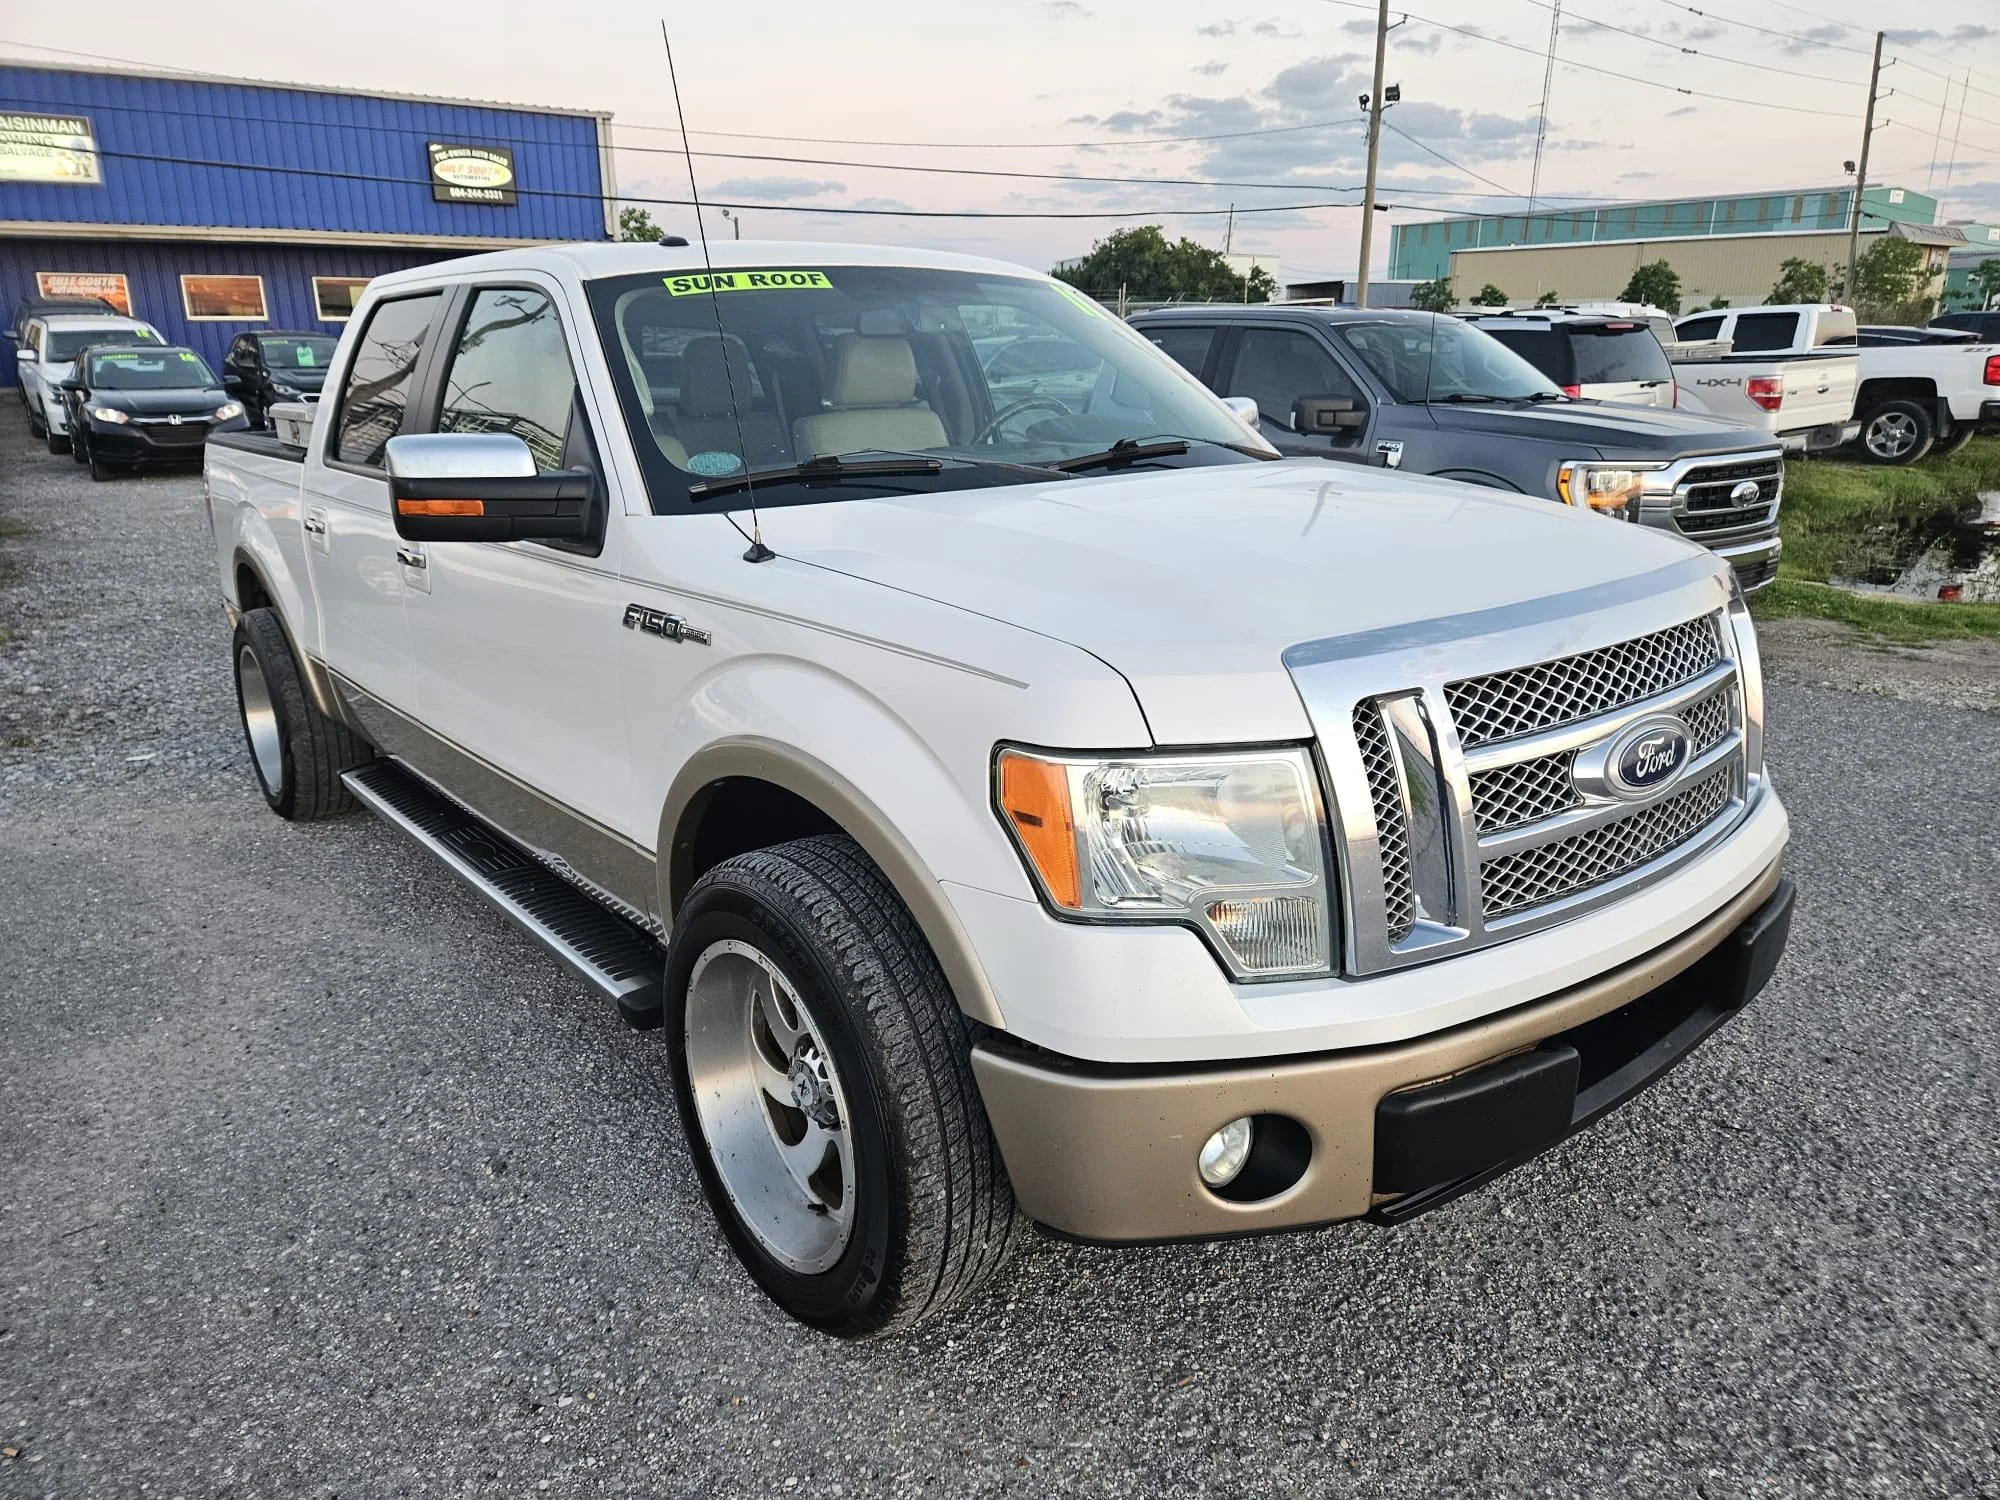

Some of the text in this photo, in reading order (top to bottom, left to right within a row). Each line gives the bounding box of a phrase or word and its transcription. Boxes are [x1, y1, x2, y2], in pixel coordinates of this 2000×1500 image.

[0, 115, 81, 134] AISINMAN
[673, 273, 823, 292] SUN ROOF
[1636, 737, 1677, 778] Ford
